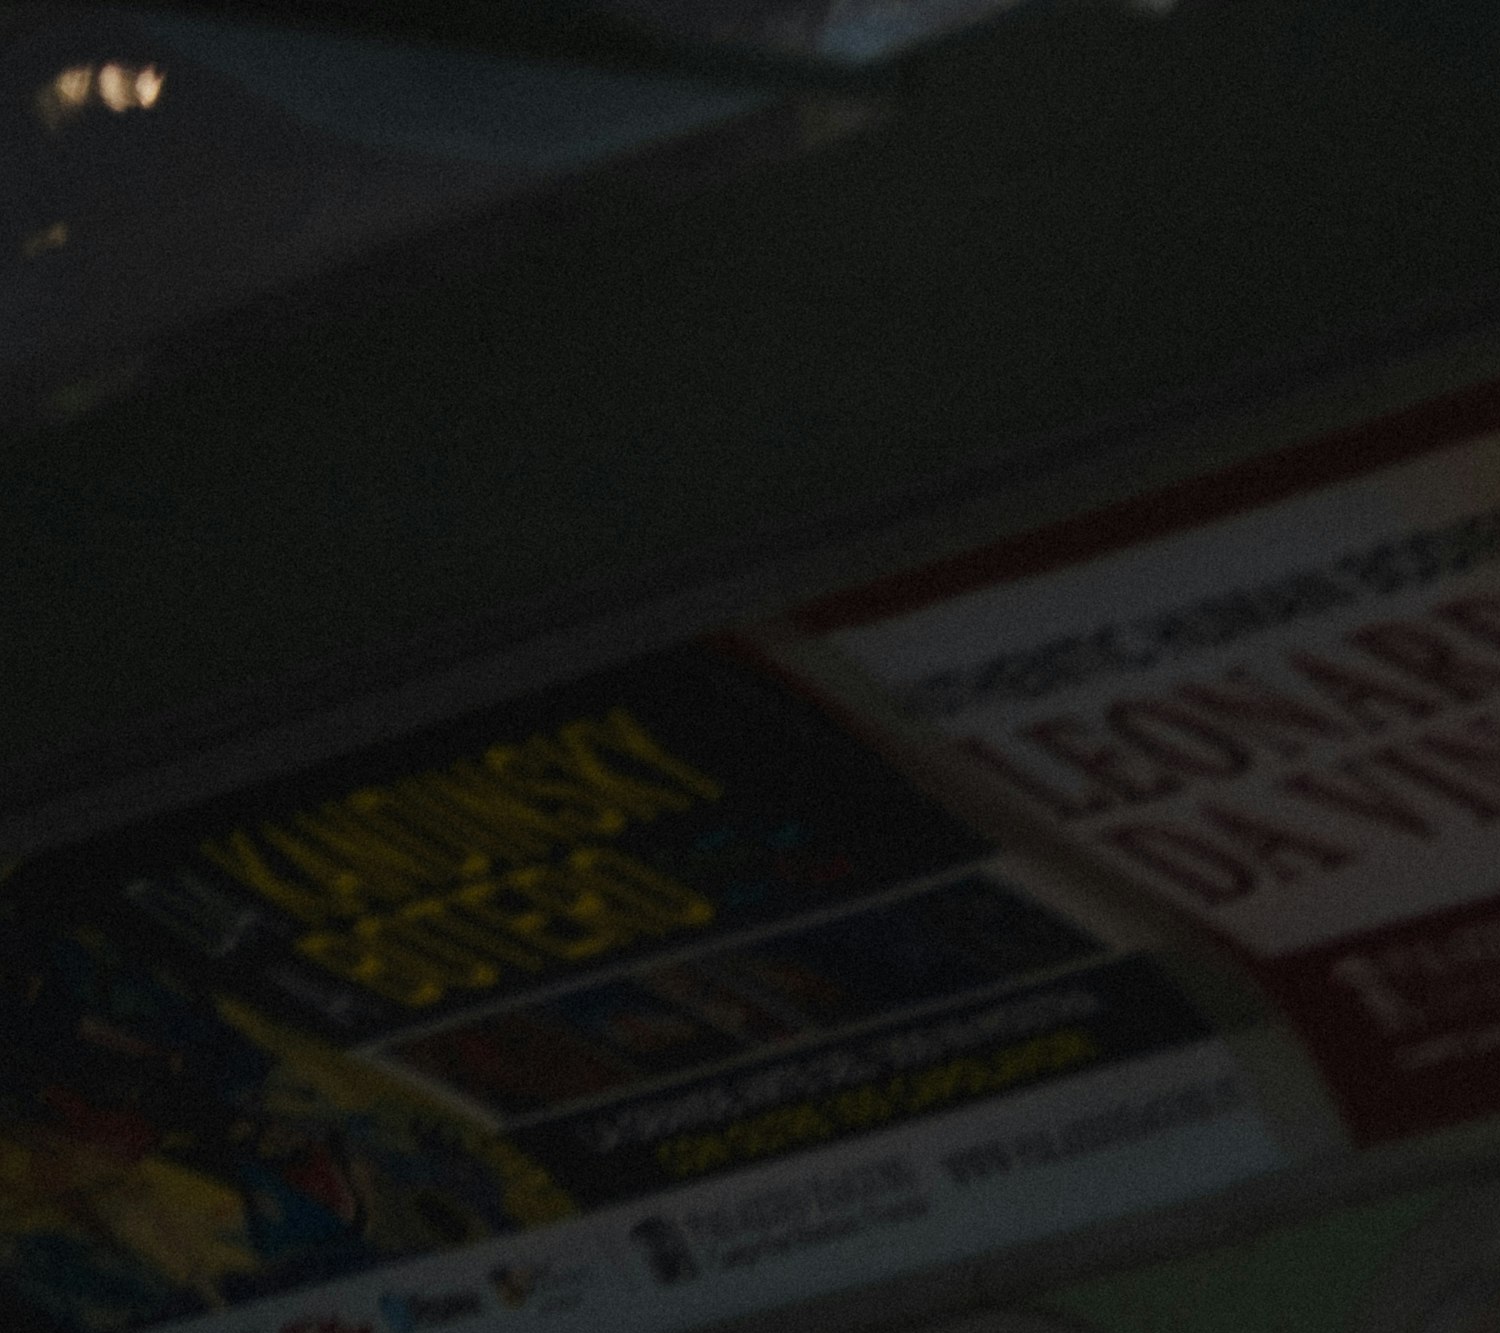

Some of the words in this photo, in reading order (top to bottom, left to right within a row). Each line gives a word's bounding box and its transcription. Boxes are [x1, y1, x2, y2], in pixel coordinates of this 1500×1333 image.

[200, 708, 725, 911] KANDINSKY
[1106, 798, 1352, 904] DA
[292, 846, 716, 1010] BOTERO
